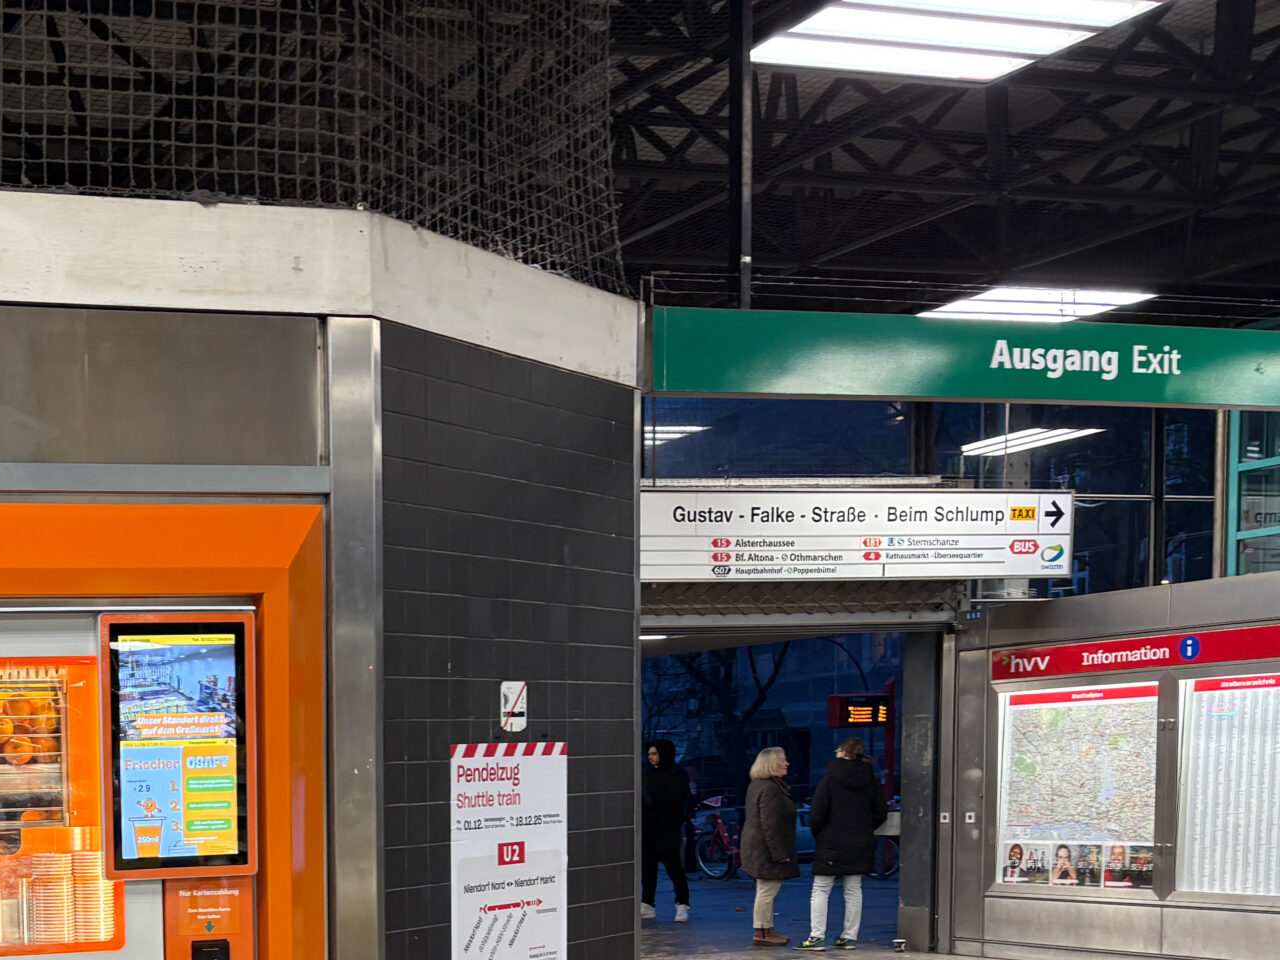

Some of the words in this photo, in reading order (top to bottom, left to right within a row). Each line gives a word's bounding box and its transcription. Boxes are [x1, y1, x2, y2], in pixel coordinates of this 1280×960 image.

[990, 340, 1119, 380] Ausgang
[1132, 345, 1182, 376] Exit
[672, 505, 733, 523] Gustav
[750, 506, 795, 523] Falke
[811, 506, 867, 523] Straße
[887, 506, 928, 522] Beim
[934, 506, 1005, 525] Schlump
[1010, 507, 1036, 520] TAXI
[716, 539, 727, 548] 15
[734, 538, 795, 548] Alsterchaussee
[907, 537, 960, 547] Sternschanze
[1013, 541, 1036, 553] BUS
[716, 553, 727, 562] 15
[735, 553, 748, 562] Bf.
[749, 553, 775, 562] Altona
[789, 553, 844, 562] Othmarschen
[735, 567, 783, 576] Hauptbahnhof
[1010, 655, 1051, 673] hvv
[1081, 646, 1170, 666] Information
[125, 758, 180, 770] Frischer
[186, 755, 229, 769] OSAFT
[457, 763, 521, 787] Pendelzug
[456, 790, 495, 809] Shuttle
[497, 789, 521, 807] train
[503, 844, 520, 862] U2
